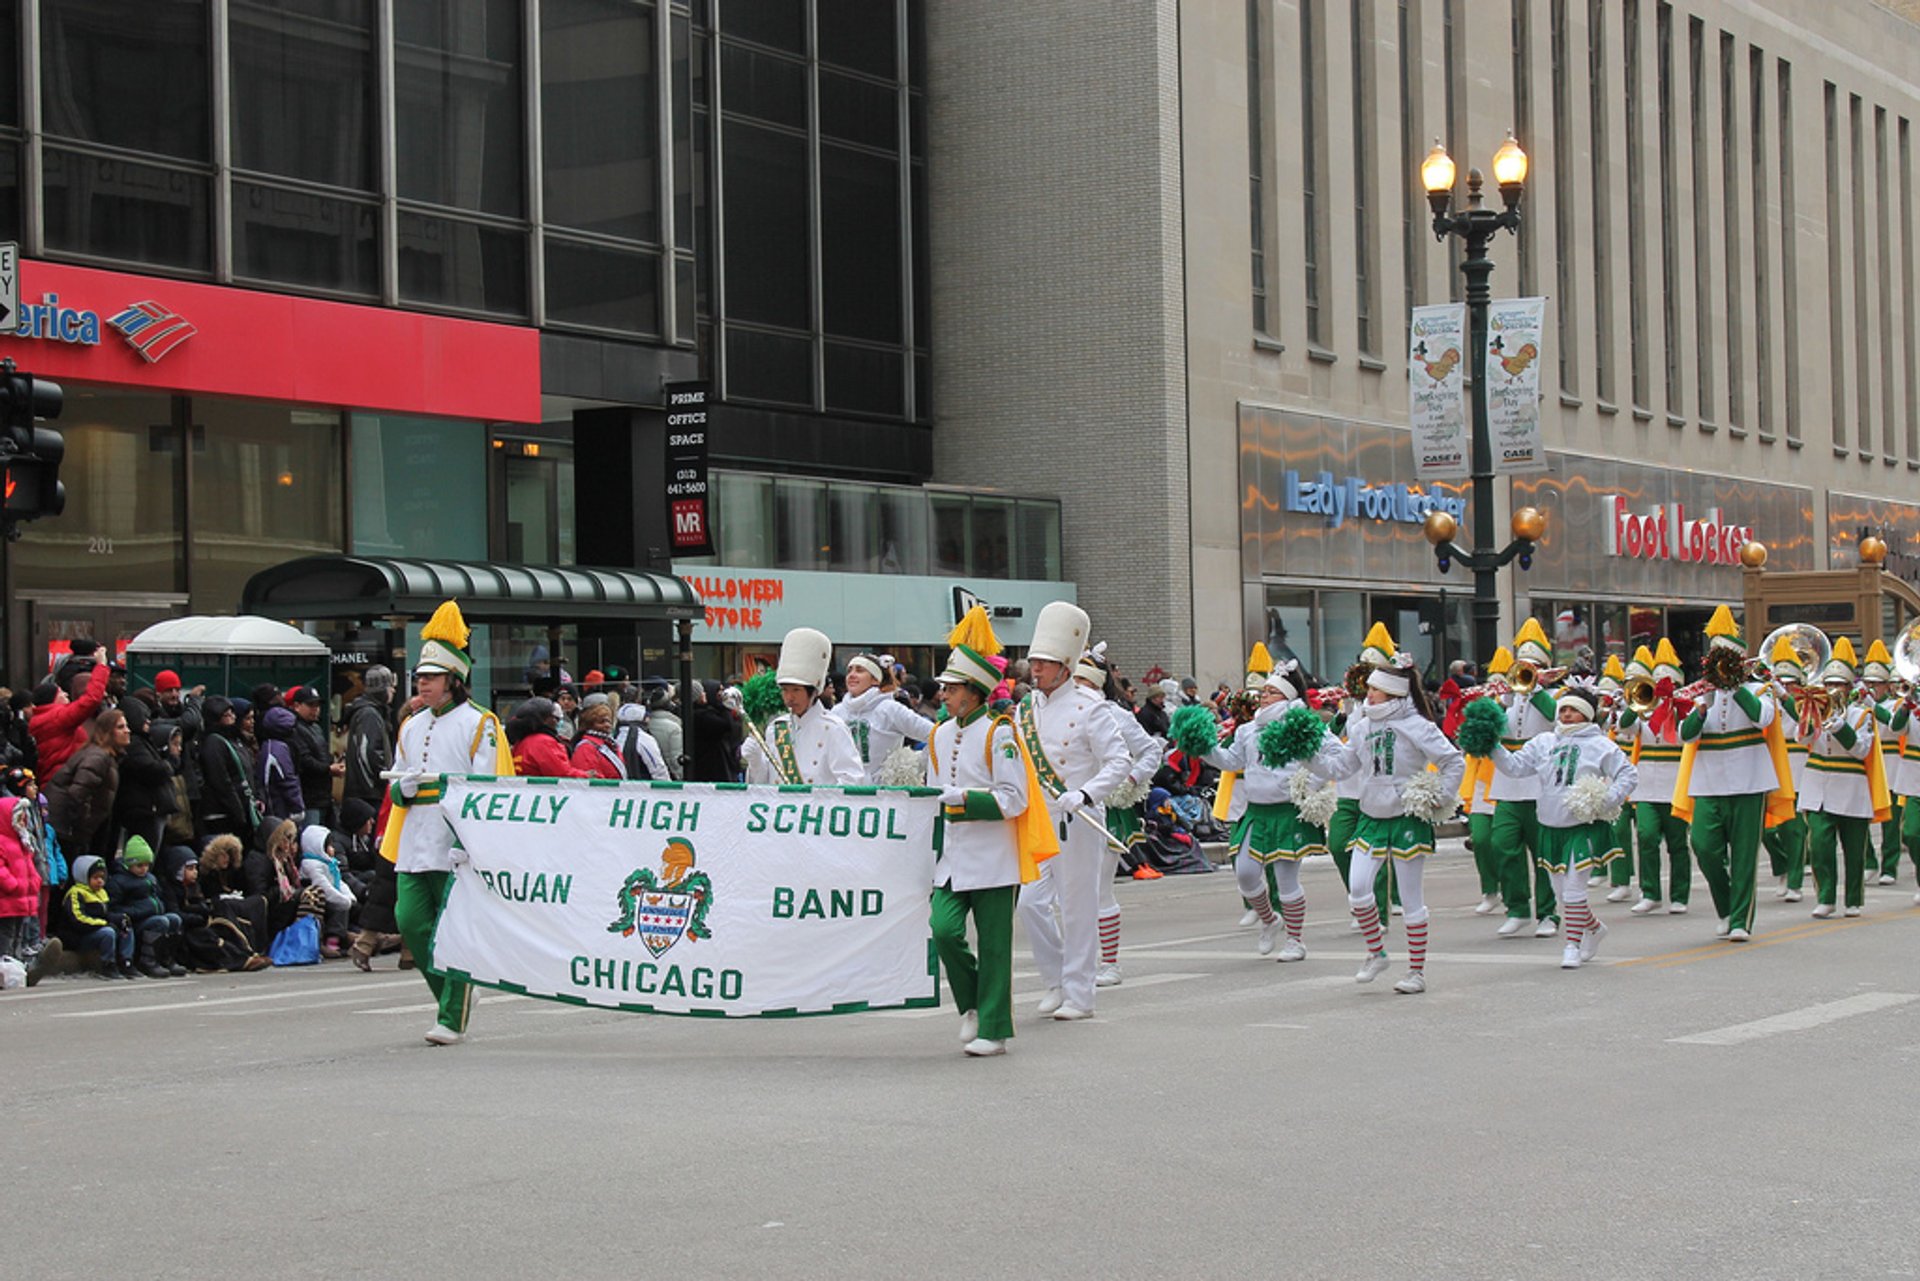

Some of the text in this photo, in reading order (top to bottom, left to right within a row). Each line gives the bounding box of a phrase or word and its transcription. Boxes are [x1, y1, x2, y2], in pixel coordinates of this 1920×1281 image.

[671, 391, 705, 405] PRIME
[667, 412, 707, 425] OFFICE
[669, 432, 705, 446] SPACE
[1503, 448, 1534, 458] CASE
[667, 481, 706, 495] 641-5600
[1285, 470, 1346, 529] Lady
[1345, 476, 1398, 521] Foot
[675, 511, 702, 534] MR
[1603, 494, 1670, 561] Foot
[88, 536, 114, 554] 201
[704, 605, 763, 633] STORE
[461, 792, 907, 840] KELLY HIGH SCHOOL
[473, 866, 884, 919] ROJAN BAND
[570, 955, 743, 1001] CHICAGO
